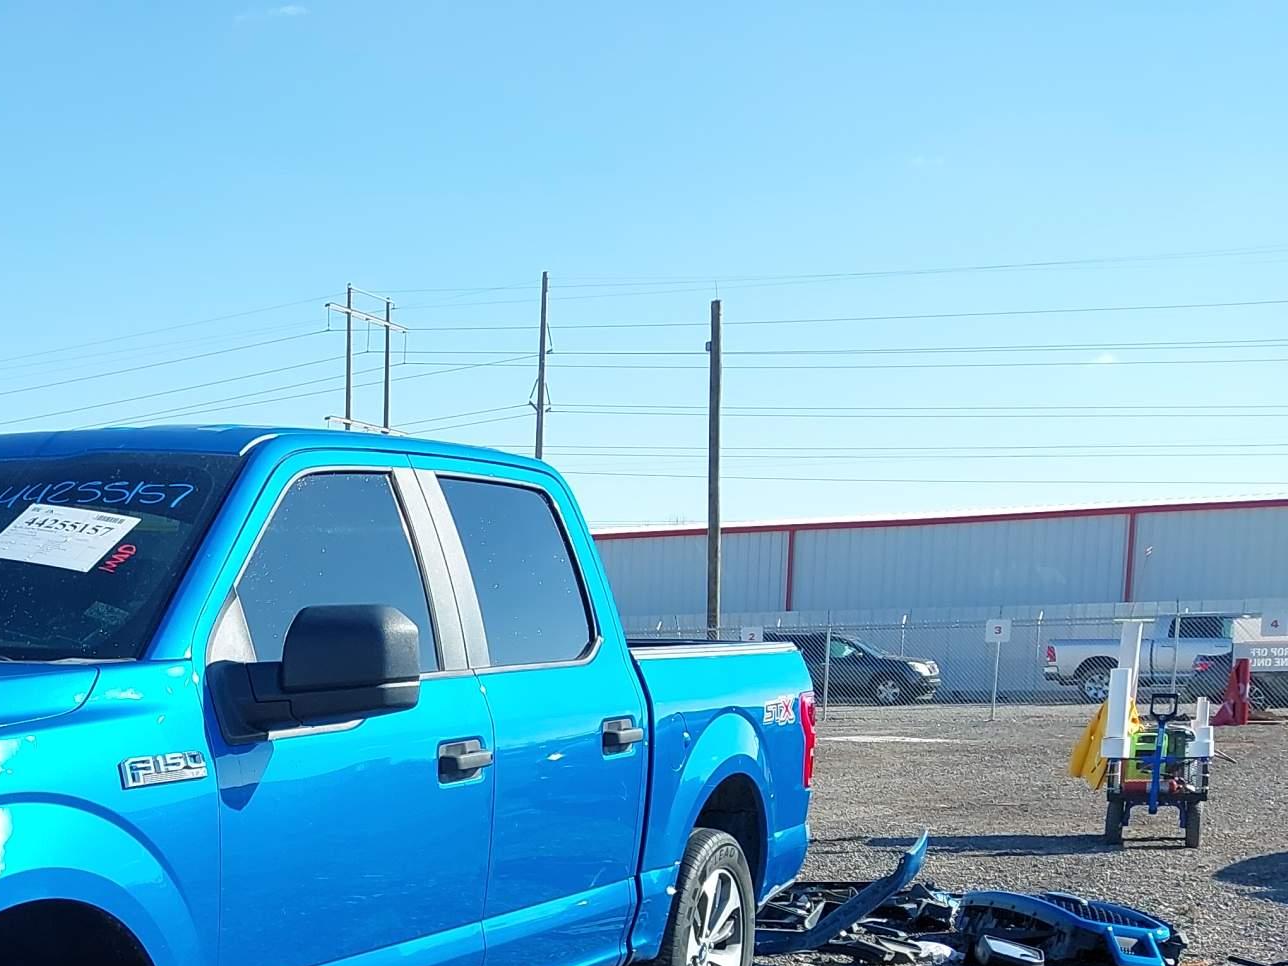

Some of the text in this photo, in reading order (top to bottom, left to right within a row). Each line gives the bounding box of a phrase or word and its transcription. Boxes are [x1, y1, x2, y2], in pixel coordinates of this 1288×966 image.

[24, 516, 116, 537] 44255157
[1270, 619, 1280, 629] 4
[994, 625, 1003, 635] 3
[748, 632, 756, 641] 2
[762, 694, 796, 726] STX
